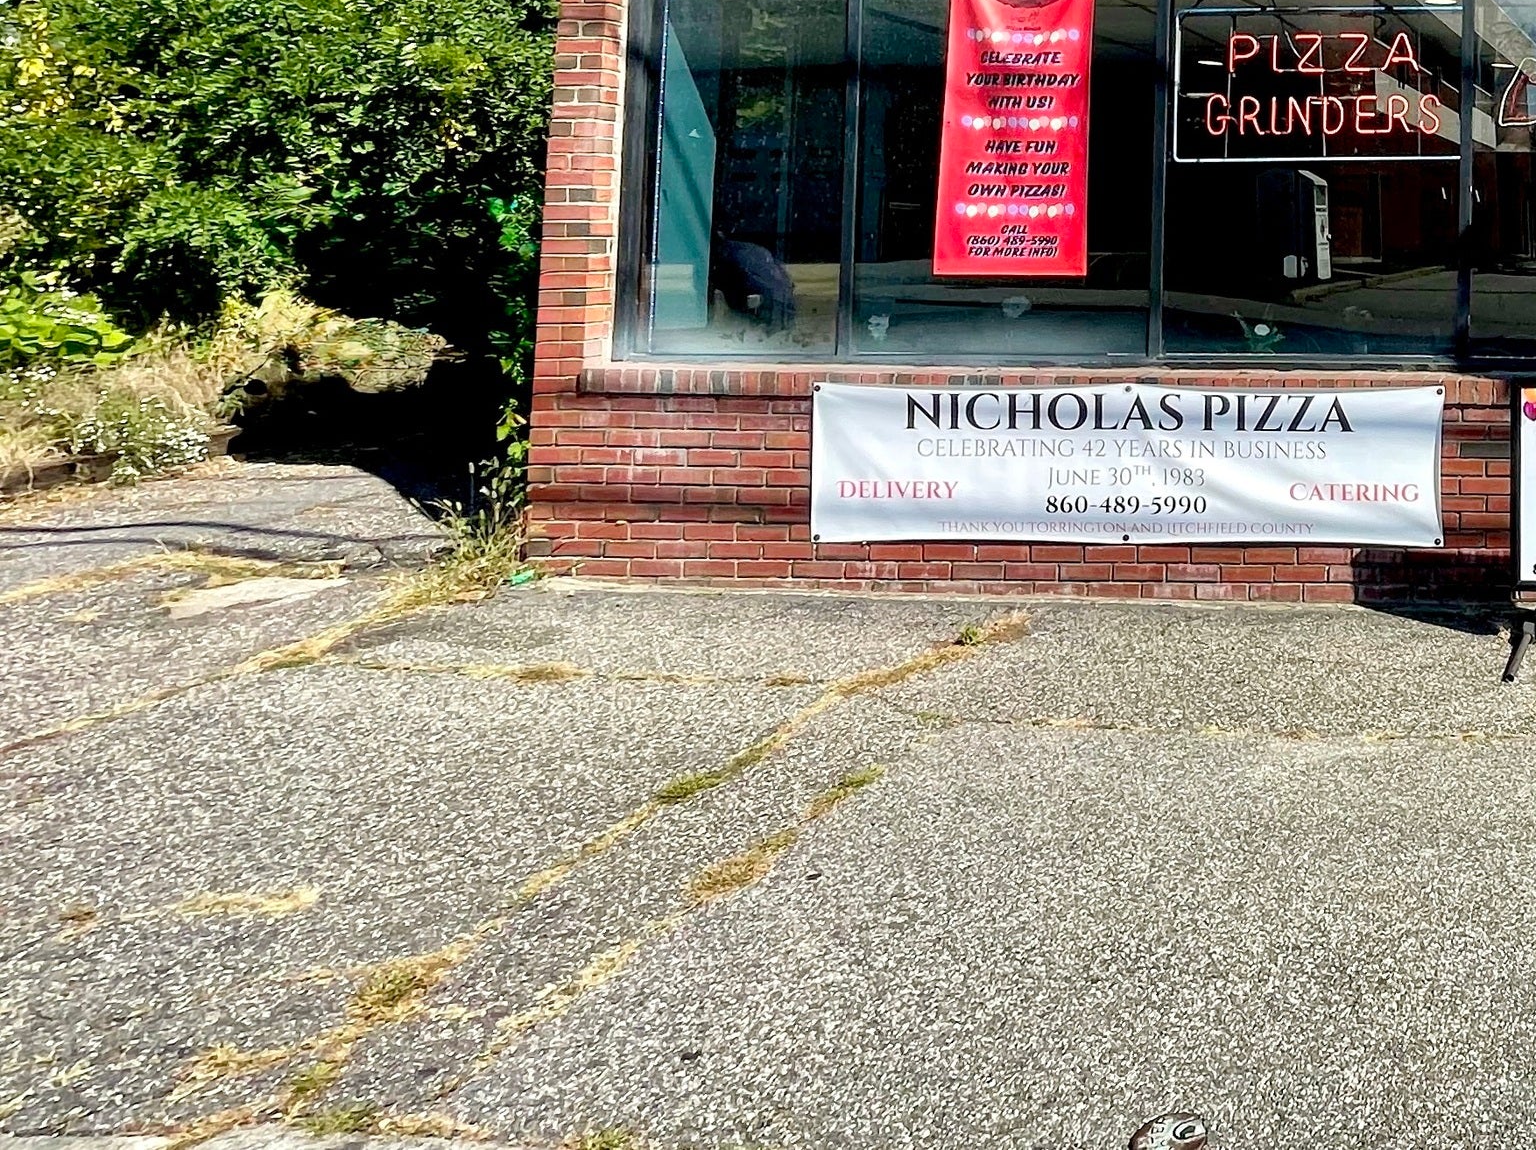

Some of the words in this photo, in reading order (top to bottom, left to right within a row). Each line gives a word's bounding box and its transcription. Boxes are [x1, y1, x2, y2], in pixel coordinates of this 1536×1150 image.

[980, 50, 1062, 66] CELEBRATE
[1227, 32, 1421, 73] PIZZA
[965, 72, 1000, 86] YOUR
[1002, 73, 1081, 87] BIRTHDAY
[1026, 96, 1056, 110] US!
[1204, 92, 1443, 136] GRINDERS
[984, 139, 1022, 154] HAVE
[1025, 140, 1057, 154] FUN
[965, 161, 1029, 176] MAKING
[1031, 161, 1071, 176] YOUR
[967, 183, 1008, 197] OWN
[1010, 184, 1067, 198] PIZZAS!
[1000, 224, 1029, 235] CALL
[966, 235, 1001, 246] (860)
[1002, 235, 1059, 246] 489-5990
[967, 246, 991, 257] FOR
[992, 247, 1028, 257] MORE
[904, 392, 1185, 432] NICHOLAS
[1200, 393, 1355, 433] PIZZA
[917, 438, 1074, 458] CELEBRATING
[1082, 439, 1106, 457] 42
[1113, 439, 1183, 458] YEARS
[1190, 440, 1216, 458] IN
[1223, 440, 1327, 460] BUSINESS
[1047, 466, 1101, 490] JUNE
[1162, 467, 1206, 488] 1983
[838, 479, 960, 500] DELIVERY
[1288, 481, 1420, 503] CATERING
[1044, 495, 1207, 515] 860-489-5990
[939, 521, 994, 534] THANK
[994, 521, 1026, 533] YOU
[1026, 521, 1127, 534] TORRINGTON
[1127, 522, 1163, 534] AND
[1167, 522, 1248, 537] LITCHFIELD
[1250, 522, 1315, 535] COUNTY
